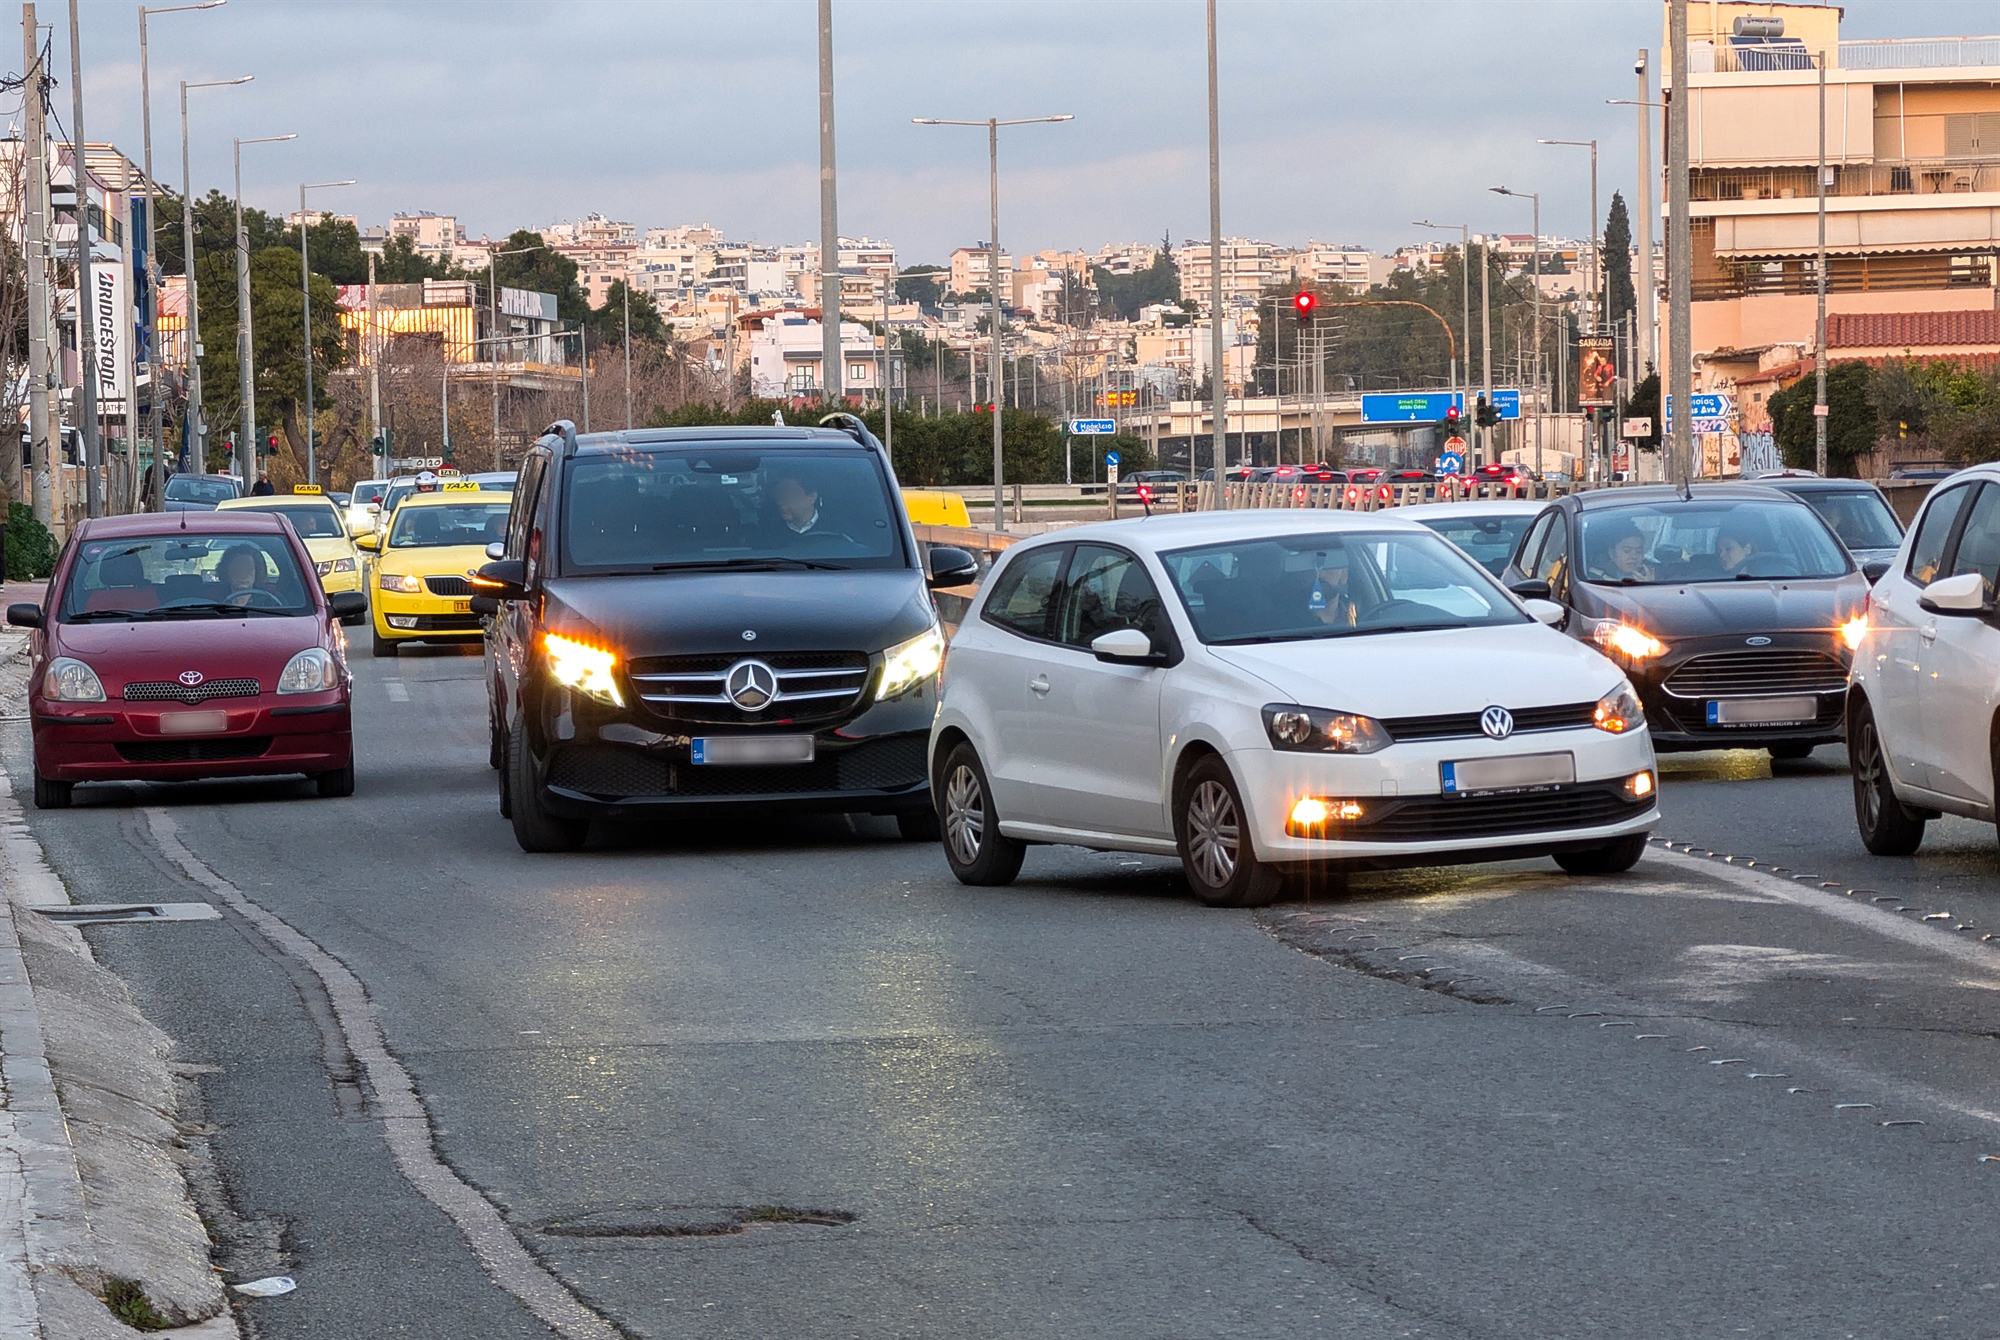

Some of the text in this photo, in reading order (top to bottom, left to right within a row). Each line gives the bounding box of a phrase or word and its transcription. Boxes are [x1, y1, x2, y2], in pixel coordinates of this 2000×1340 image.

[98, 271, 115, 391] BRIDGESTONE
[1579, 339, 1613, 347] SANKARA
[1447, 442, 1465, 453] STOP
[446, 482, 476, 490] TAXI
[1444, 779, 1455, 787] GR
